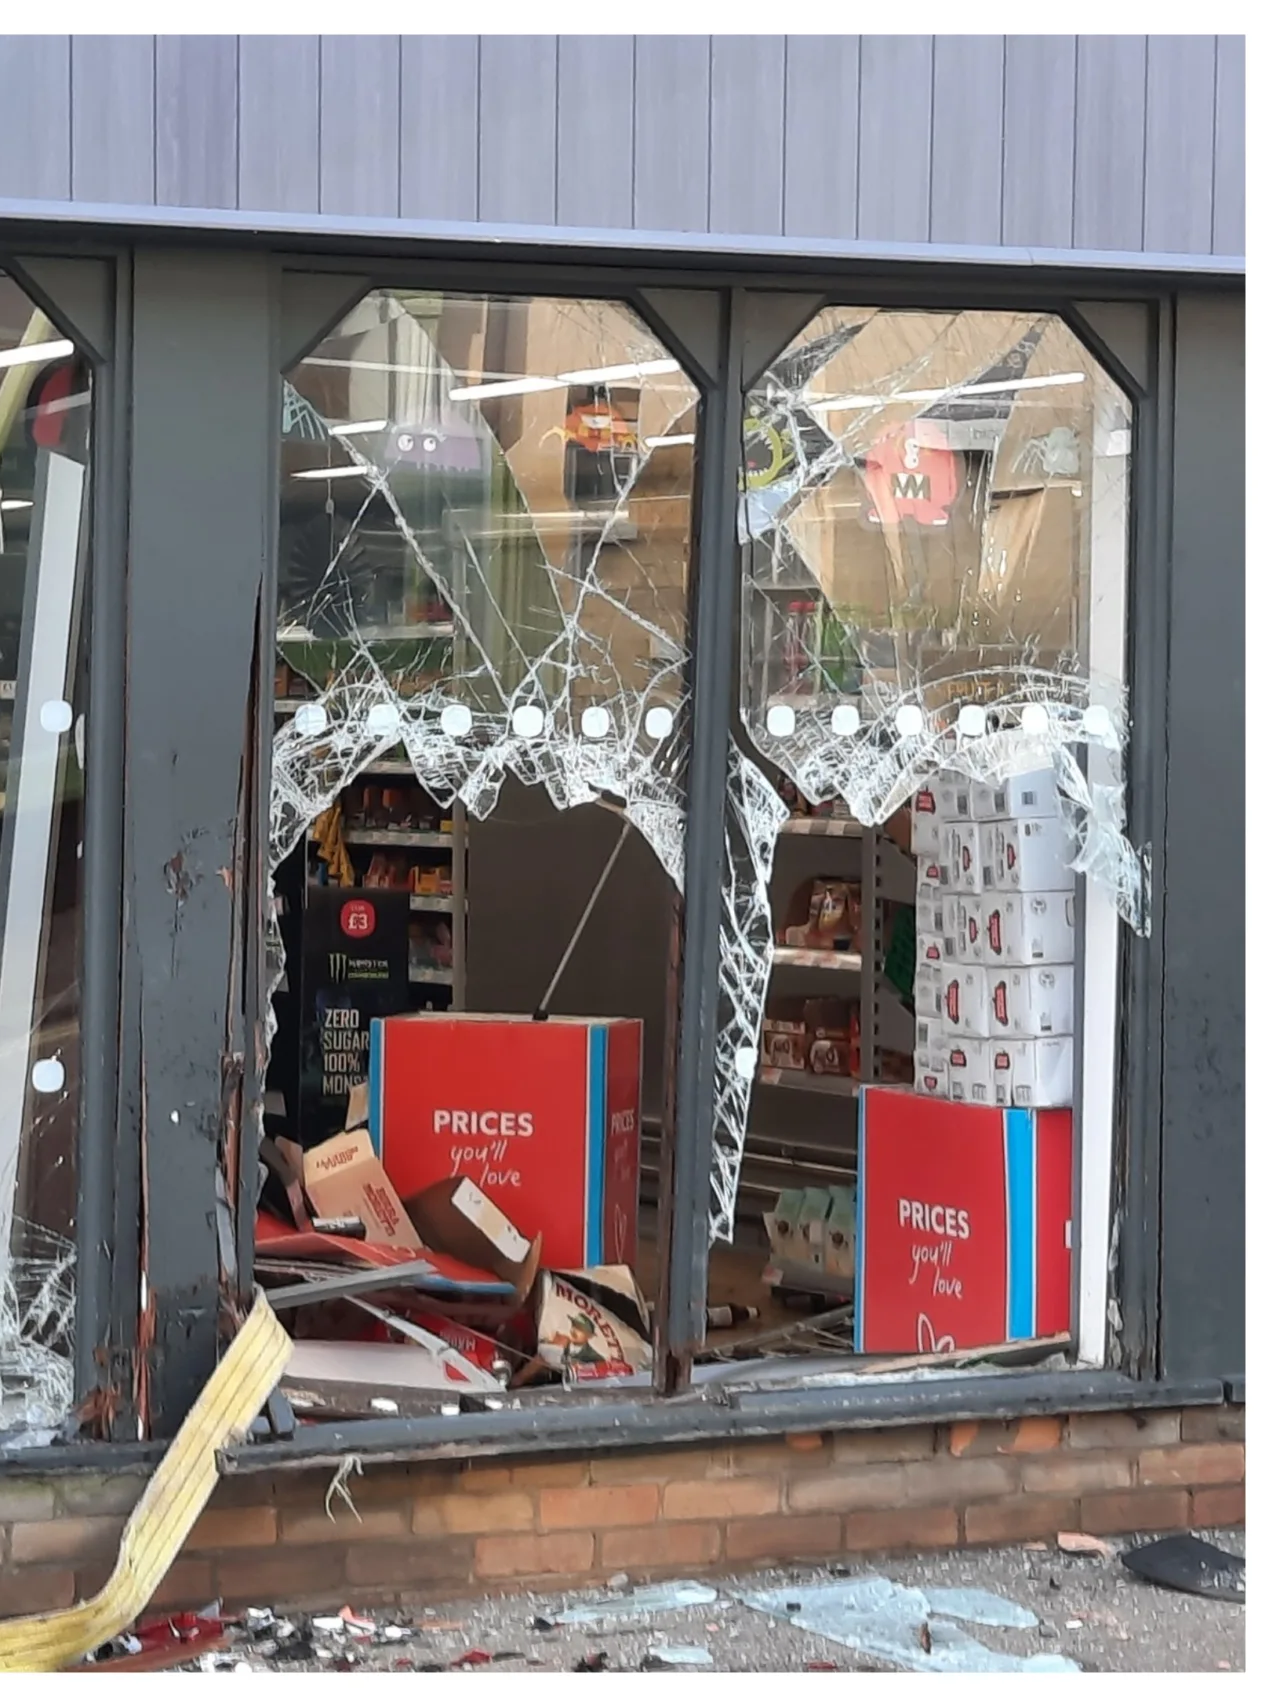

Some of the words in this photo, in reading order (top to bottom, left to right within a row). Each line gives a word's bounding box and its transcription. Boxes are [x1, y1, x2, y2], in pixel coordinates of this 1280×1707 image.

[348, 912, 368, 930] £3
[324, 1007, 360, 1029] ZERO
[322, 1030, 370, 1051] SUGAR
[323, 1052, 361, 1074] 100%
[433, 1109, 534, 1137] PRICES
[450, 1138, 508, 1179] you'll
[480, 1161, 522, 1188] love
[898, 1198, 970, 1240] PRICES
[908, 1241, 953, 1286] you'll
[932, 1265, 963, 1300] love
